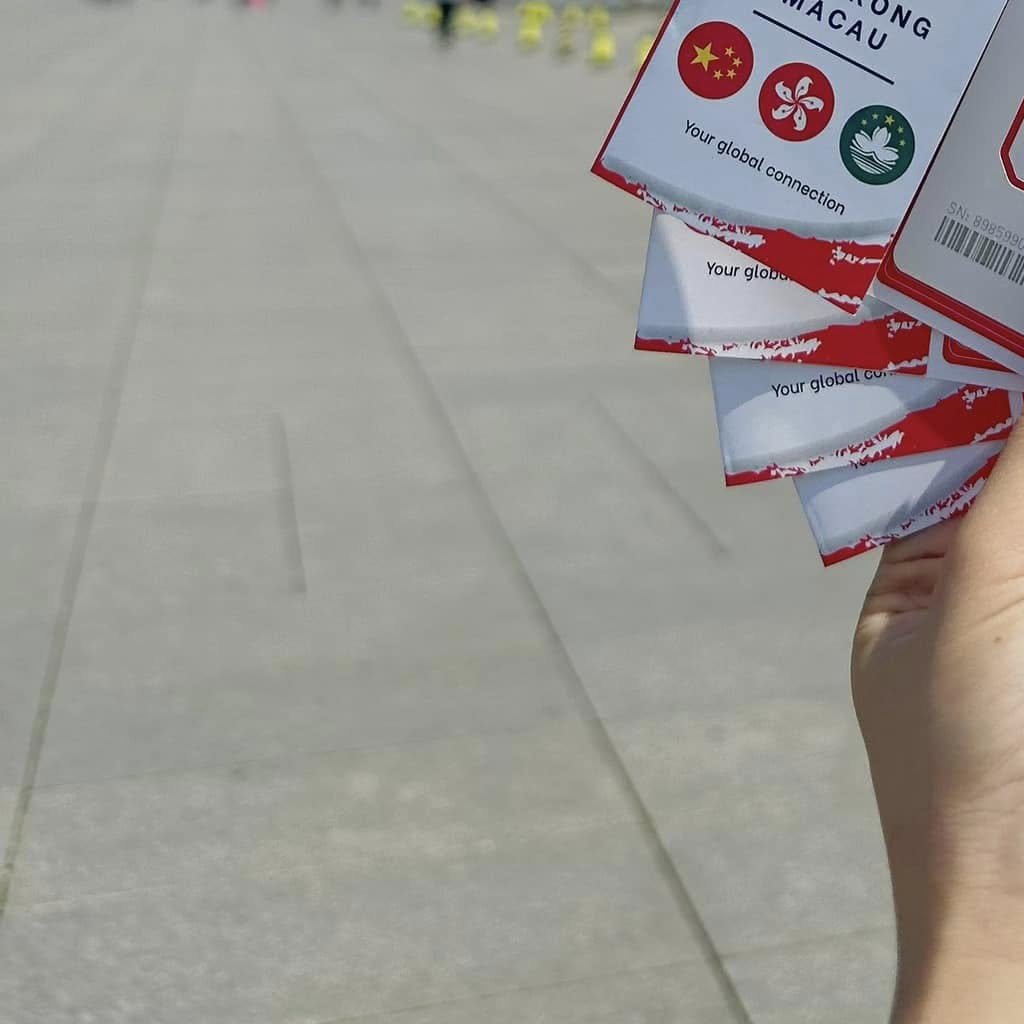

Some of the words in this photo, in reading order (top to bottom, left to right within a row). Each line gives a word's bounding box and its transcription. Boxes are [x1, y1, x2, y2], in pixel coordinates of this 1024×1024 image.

[684, 120, 716, 145] Your
[717, 139, 765, 171] global
[765, 165, 846, 215] connection
[947, 201, 970, 222] SN:
[706, 261, 741, 277] Your
[771, 383, 805, 398] Your
[810, 368, 860, 394] global
